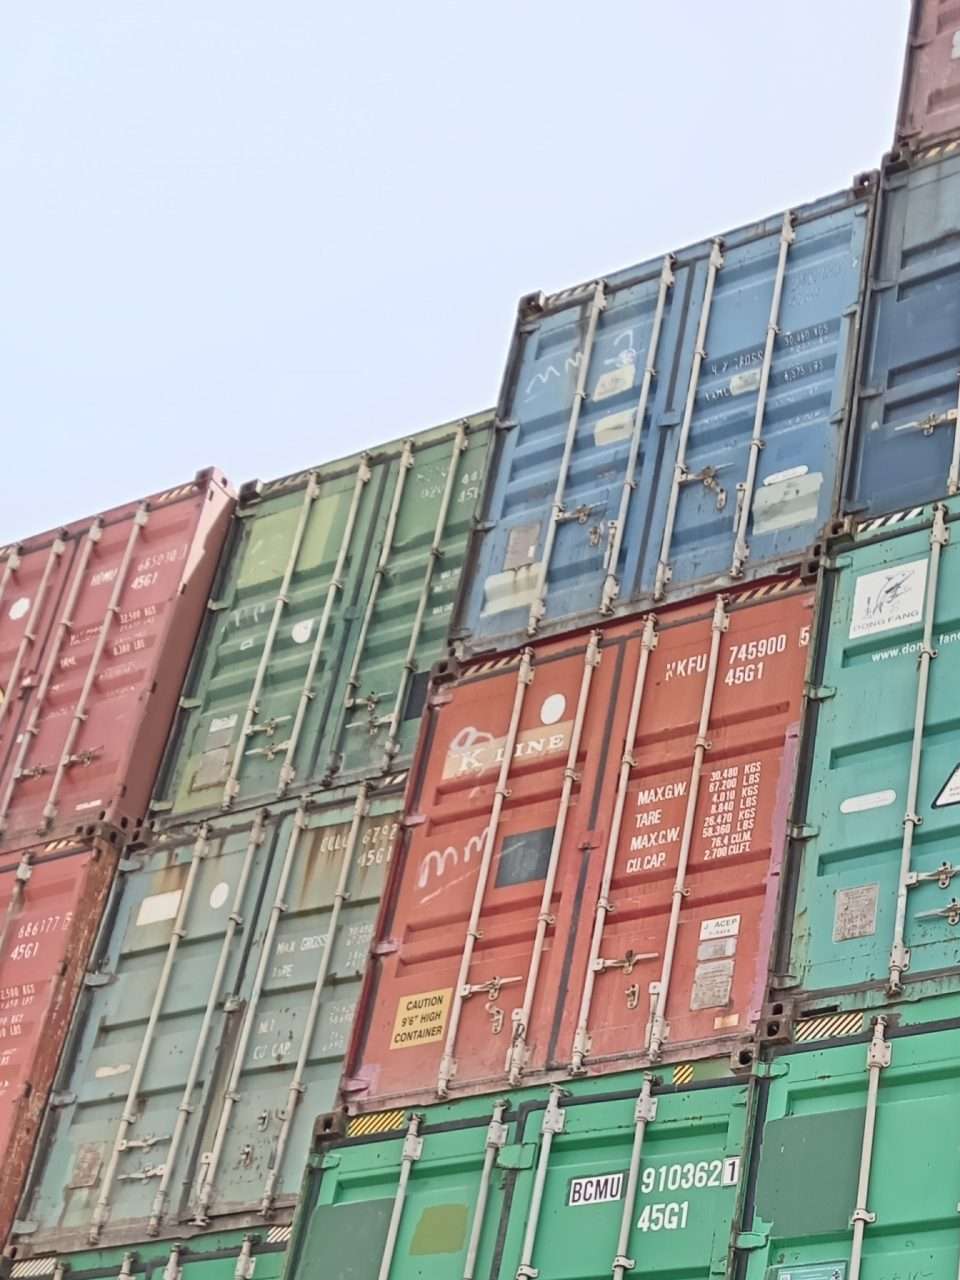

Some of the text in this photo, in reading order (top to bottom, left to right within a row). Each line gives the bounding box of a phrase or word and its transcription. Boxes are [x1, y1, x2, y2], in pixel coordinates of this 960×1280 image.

[728, 634, 786, 664] 745900
[724, 661, 764, 686] 45G1
[744, 762, 761, 774] KGS
[635, 809, 662, 828] TARE
[742, 785, 759, 797] KGS
[738, 808, 755, 820] KGS
[406, 994, 444, 1011] CAUTION
[420, 1010, 442, 1024] HIGH
[394, 1025, 443, 1044] CONTAINER
[572, 1176, 622, 1202] BCMU
[641, 1159, 722, 1194] 910362
[637, 1201, 689, 1232] 45G1
